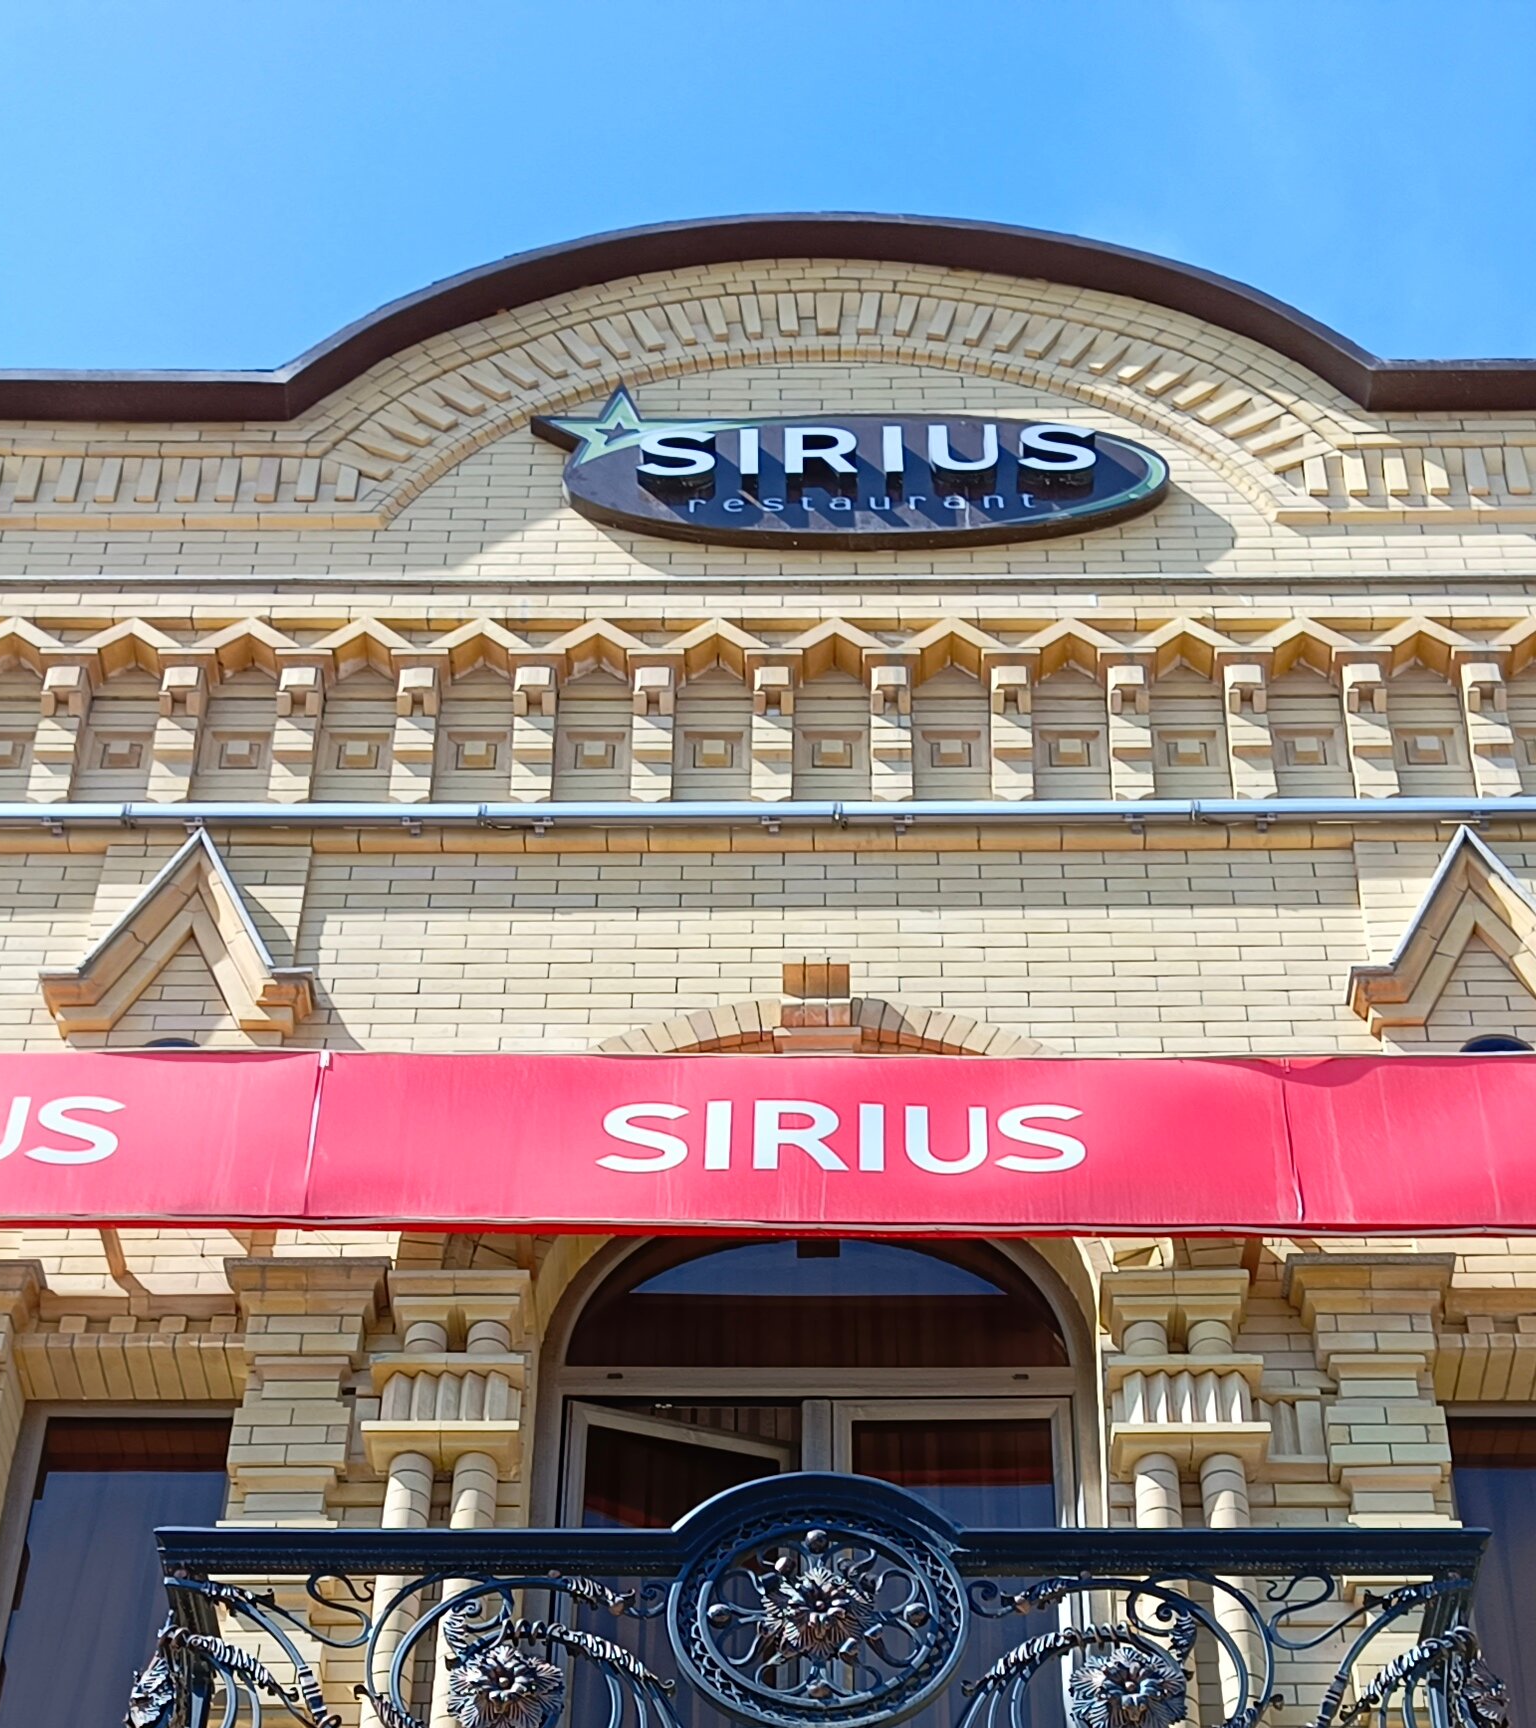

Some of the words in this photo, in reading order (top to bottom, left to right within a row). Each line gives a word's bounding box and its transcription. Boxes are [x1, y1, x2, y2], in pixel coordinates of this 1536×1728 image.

[636, 423, 1098, 476] SIRIUS
[686, 491, 1036, 514] restaurant
[595, 1101, 1086, 1174] SIRIUS
